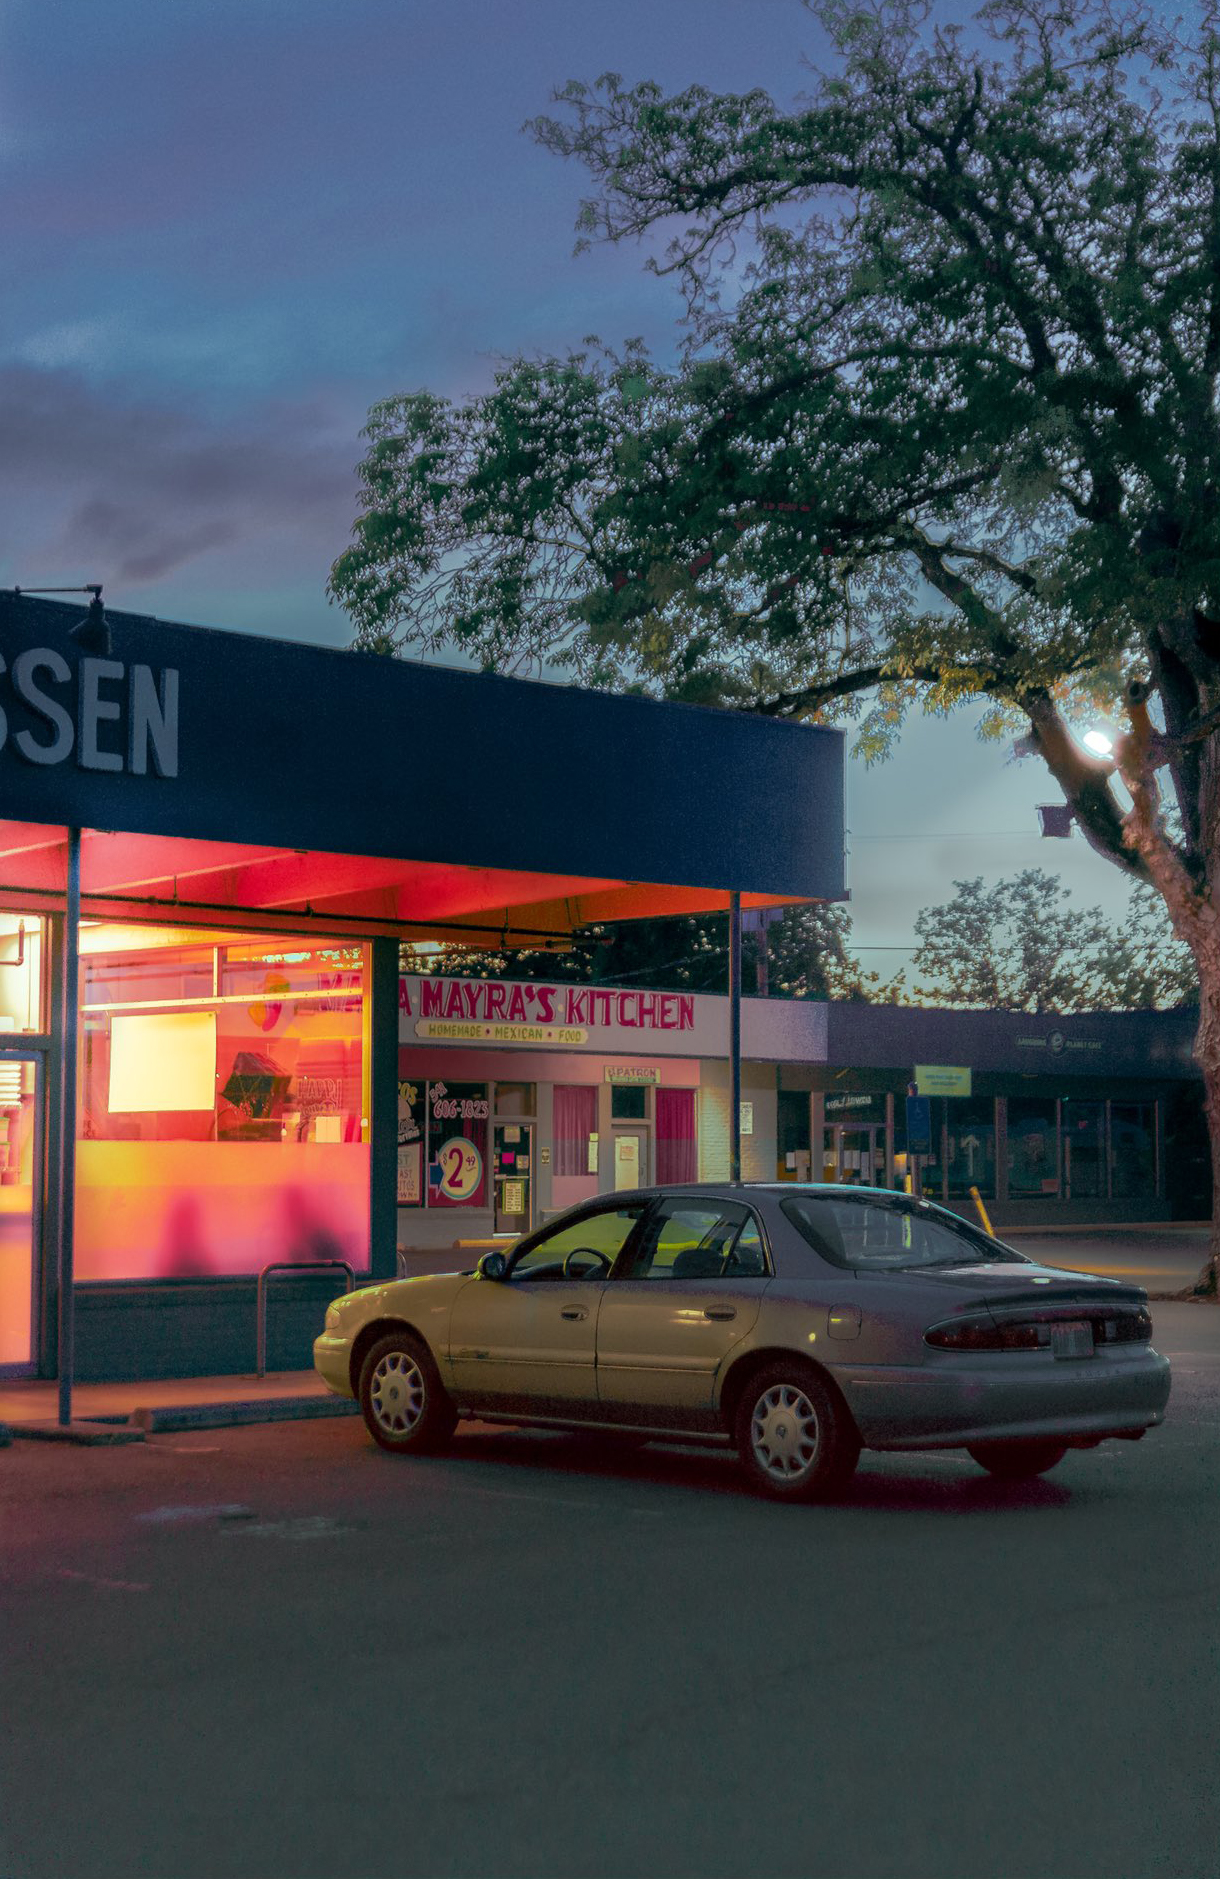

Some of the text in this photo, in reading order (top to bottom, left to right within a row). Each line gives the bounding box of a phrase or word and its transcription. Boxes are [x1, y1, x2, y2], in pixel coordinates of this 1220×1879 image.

[420, 980, 557, 1023] MAYRA'S
[565, 988, 694, 1031] KITCHEN
[429, 1024, 582, 1043] HOMEMADE MEXICAN FOOD
[433, 1099, 489, 1119] 606-1823
